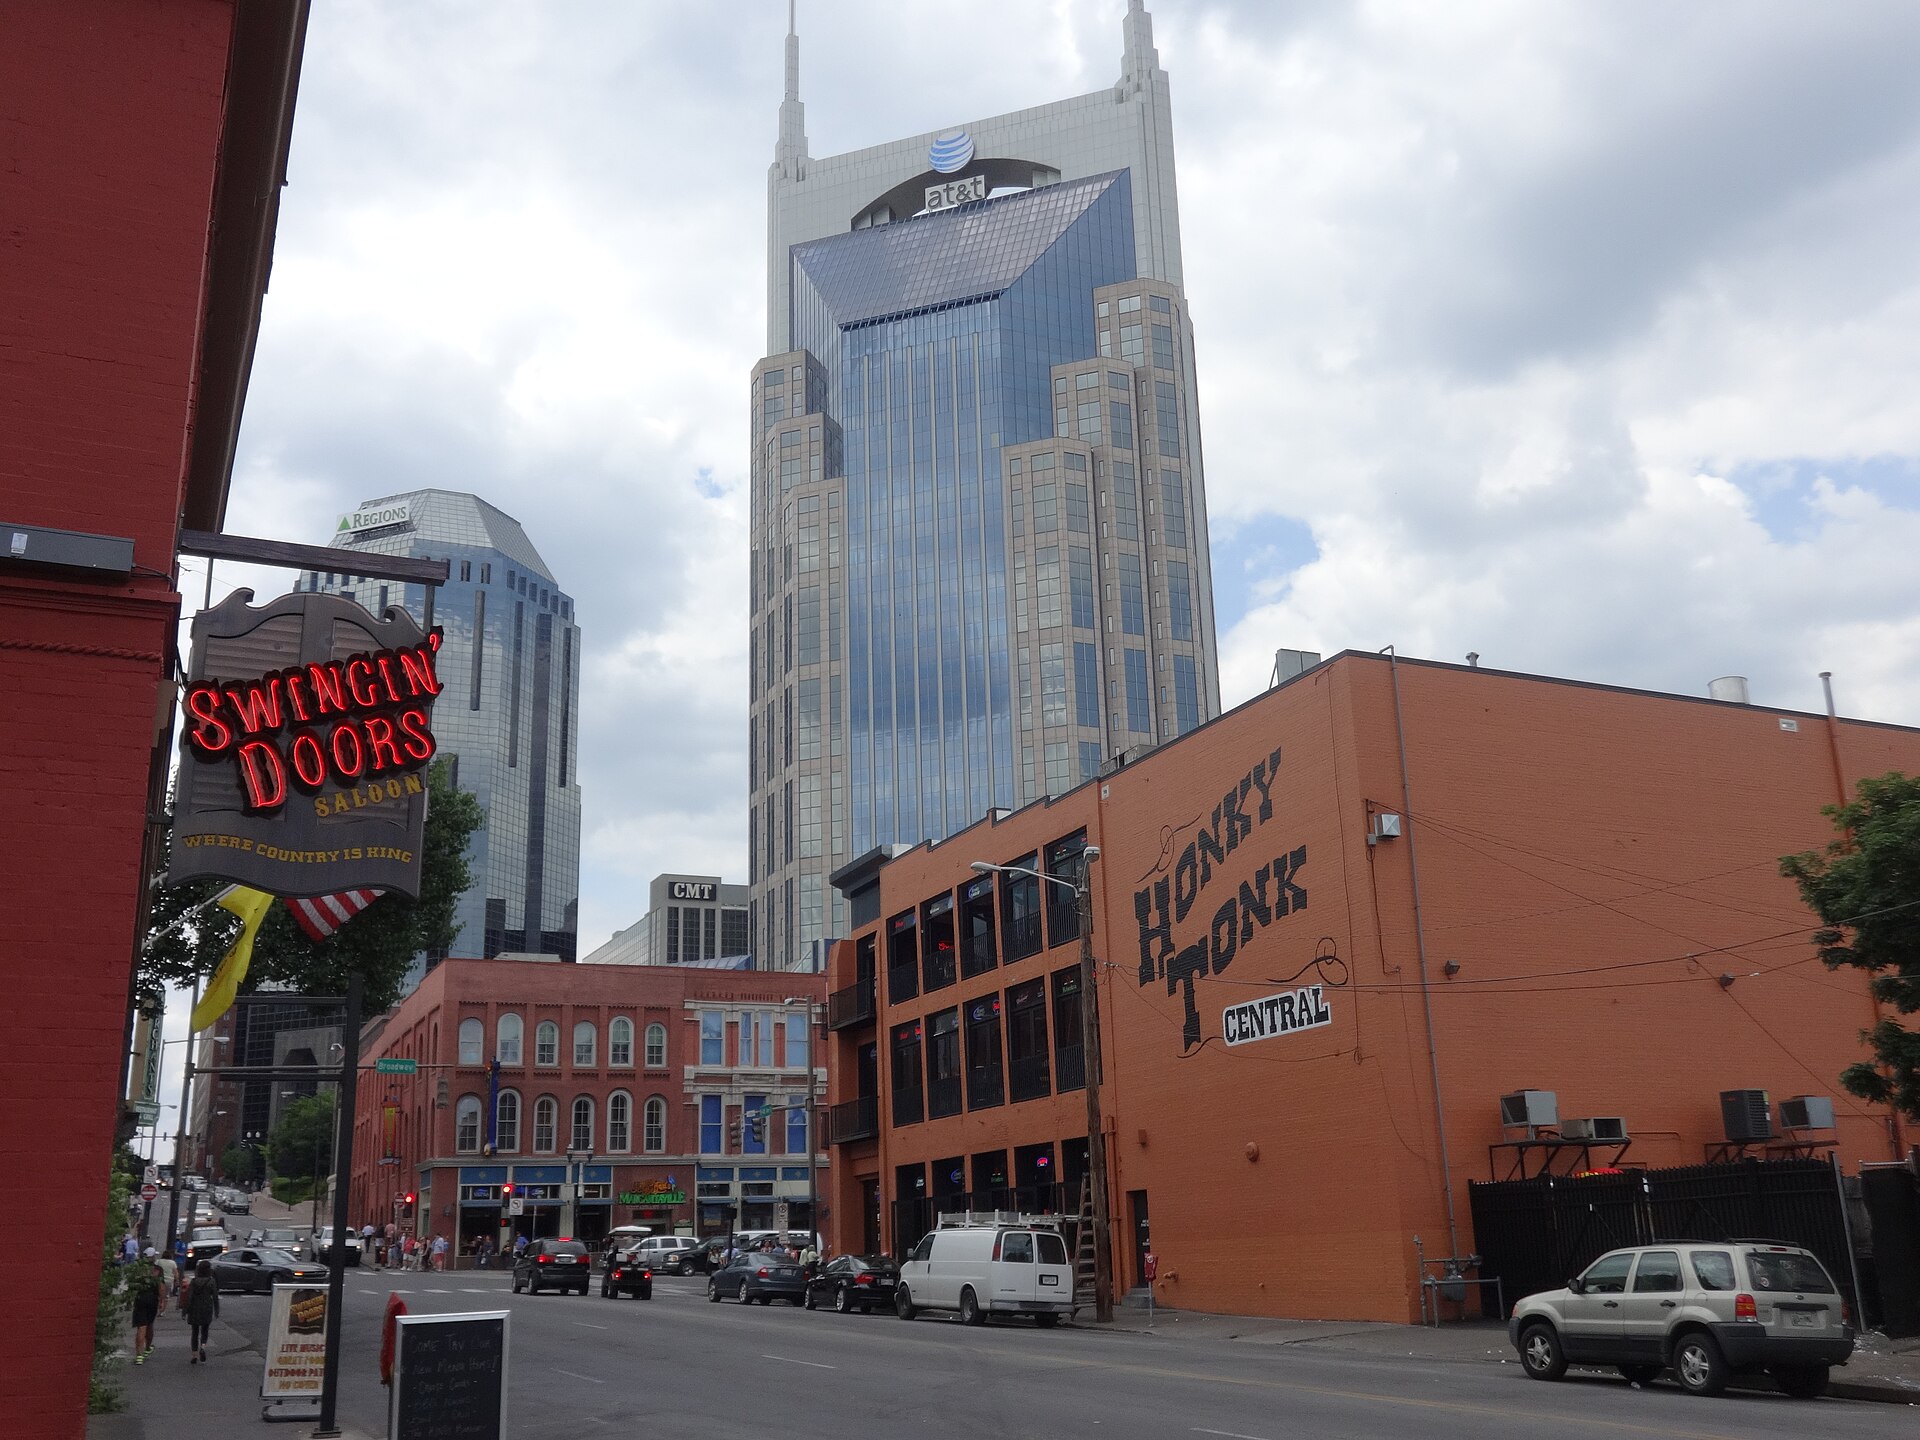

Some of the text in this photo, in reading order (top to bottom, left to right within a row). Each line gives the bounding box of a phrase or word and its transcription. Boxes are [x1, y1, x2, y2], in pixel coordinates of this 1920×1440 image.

[927, 177, 982, 209] at&t
[185, 630, 443, 755] SWINGIN'
[237, 708, 436, 812] DOORS
[314, 772, 423, 818] SALOON
[182, 833, 413, 864] WHERE COUNTRY IS KING
[1133, 745, 1282, 988] HONKY
[673, 882, 712, 899] CMT
[1166, 843, 1308, 1053] TONK
[1223, 986, 1330, 1044] CENTRAL
[378, 1061, 414, 1072] Broadway
